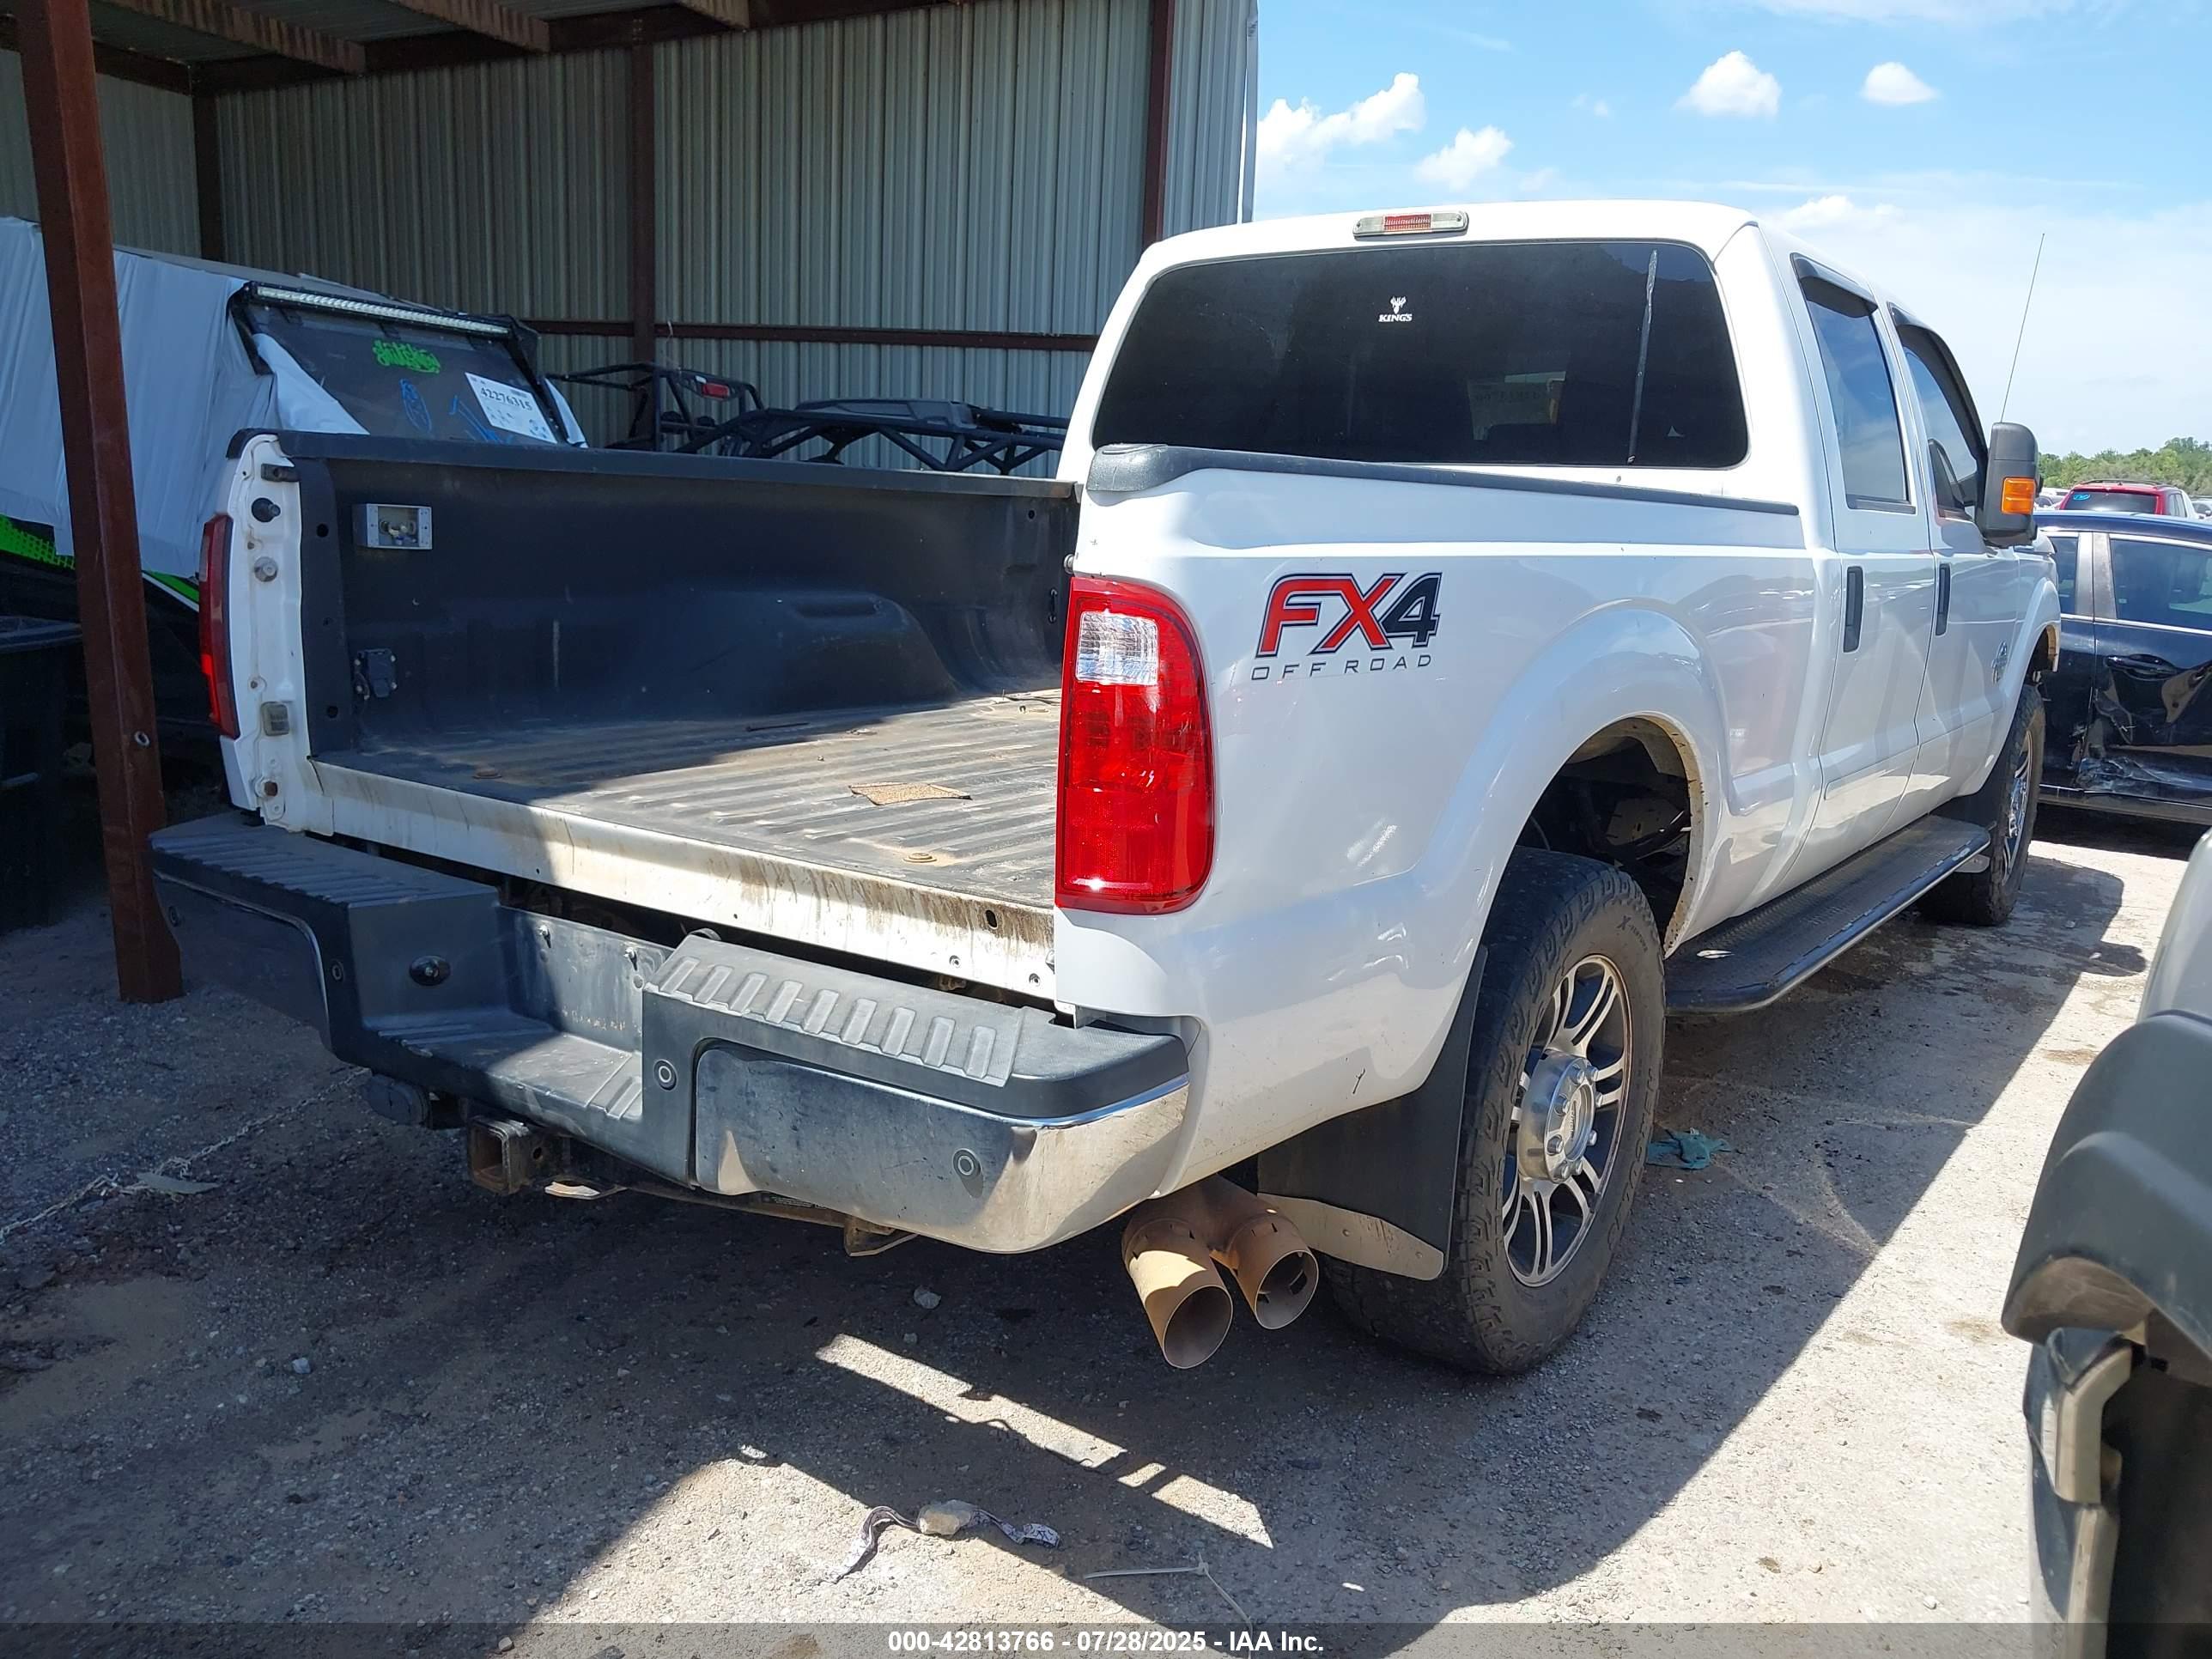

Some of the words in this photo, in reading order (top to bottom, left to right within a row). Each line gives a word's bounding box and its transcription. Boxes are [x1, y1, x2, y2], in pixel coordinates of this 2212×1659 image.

[481, 387, 532, 410] 42276315
[1255, 572, 1443, 659] FX4
[1250, 662, 1327, 680] OFF
[1344, 654, 1431, 674] ROAD
